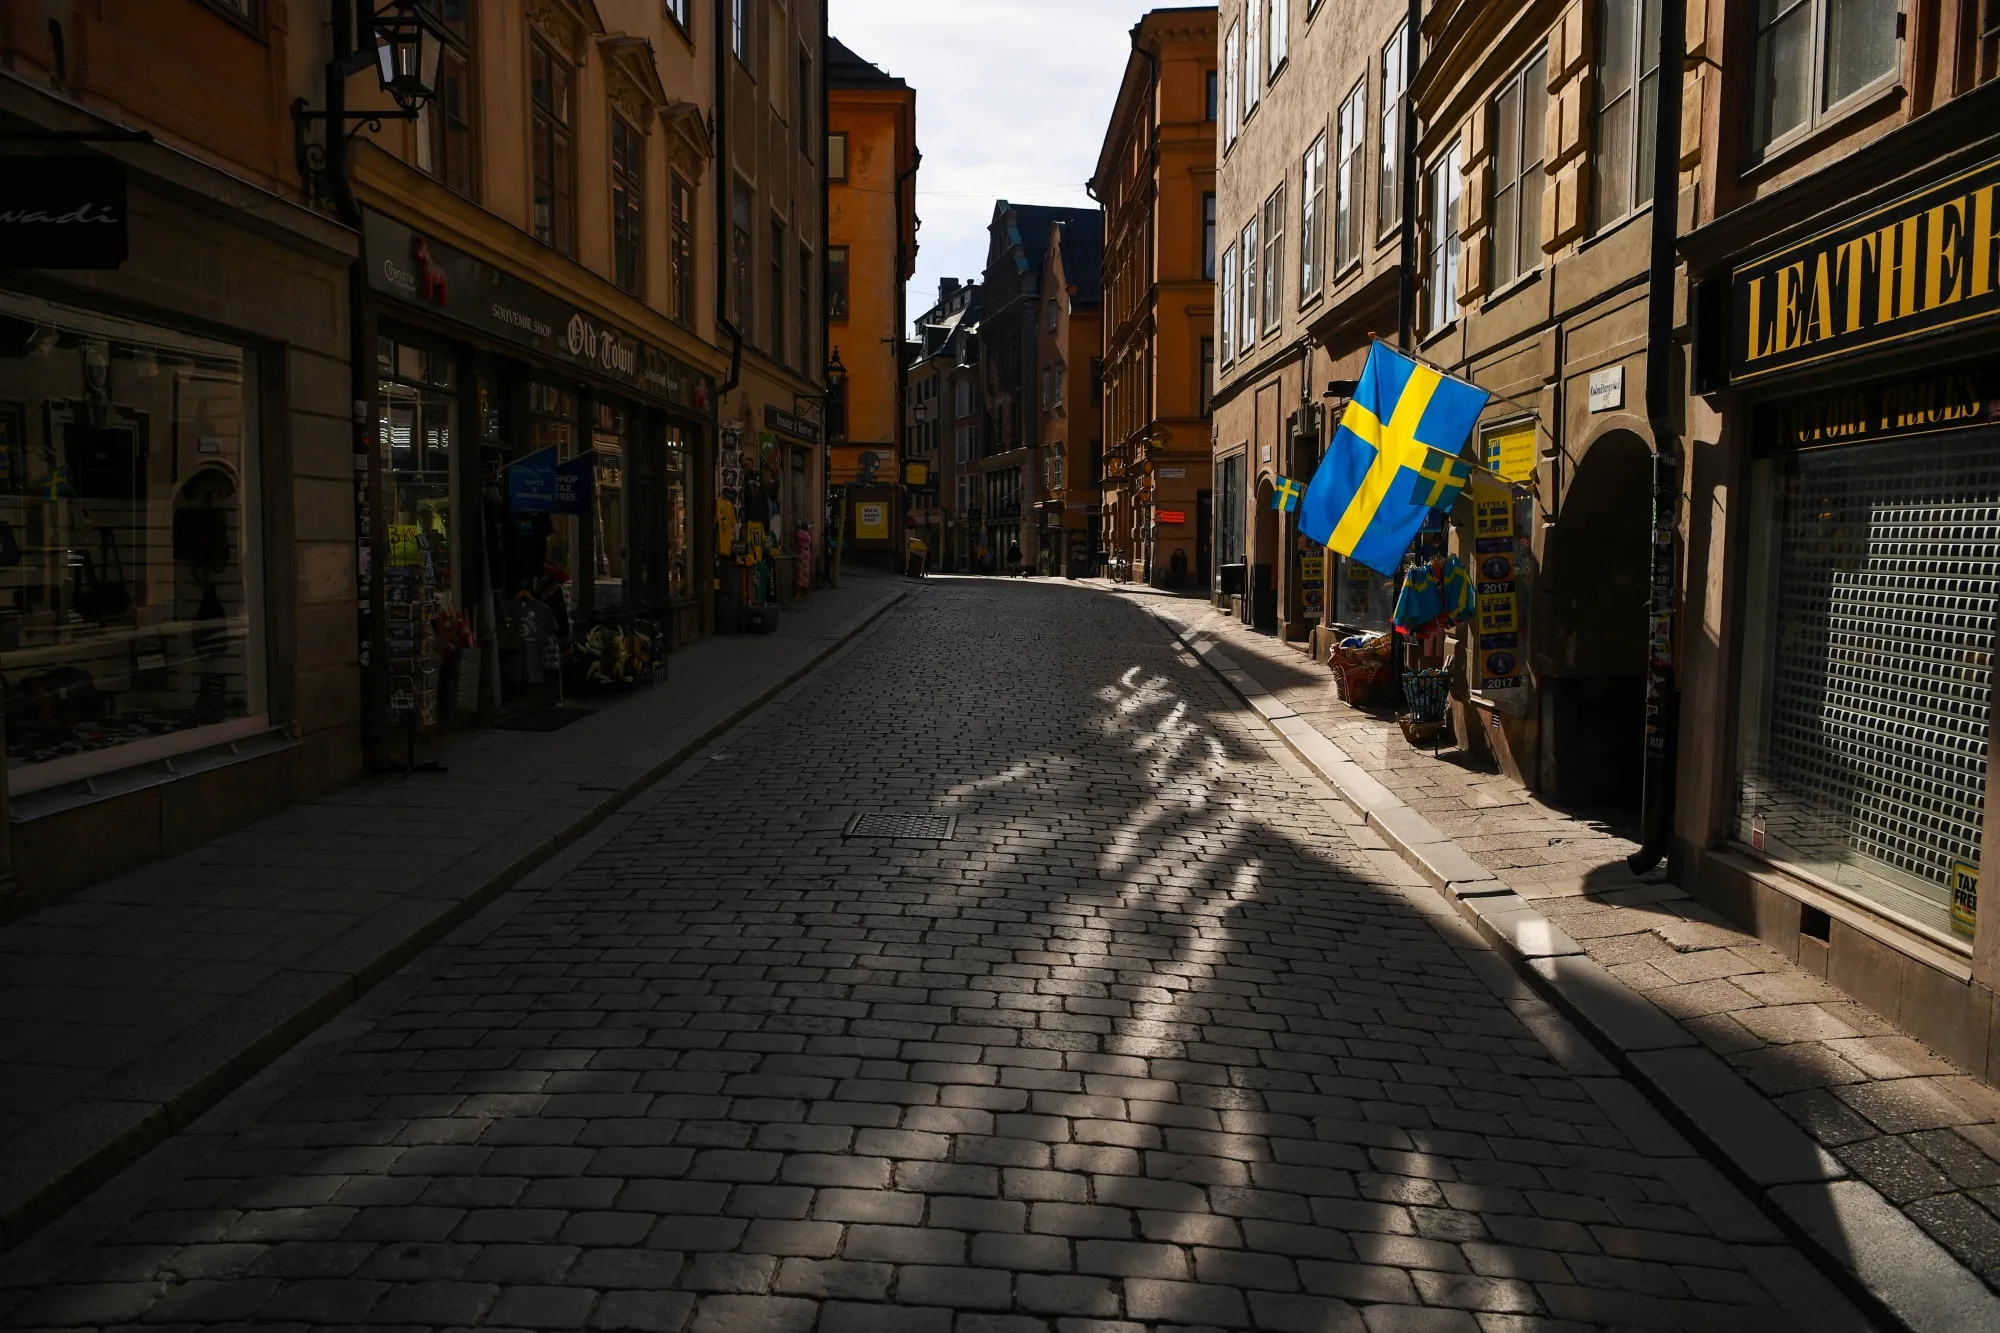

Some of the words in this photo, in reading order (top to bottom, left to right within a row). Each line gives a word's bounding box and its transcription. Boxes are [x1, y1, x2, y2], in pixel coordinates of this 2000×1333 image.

[491, 303, 532, 332] SOUVENIR
[533, 320, 552, 339] SHOP
[566, 313, 597, 360] Old
[600, 330, 634, 376] Town
[555, 475, 578, 483] SHOP
[555, 484, 572, 492] TAX
[555, 493, 577, 501] FREE
[1483, 583, 1509, 593] 2017
[1482, 597, 1511, 605] LITTLE
[1483, 622, 1513, 630] SWEDEN
[1487, 678, 1514, 689] 2017
[1957, 873, 1977, 893] TAX
